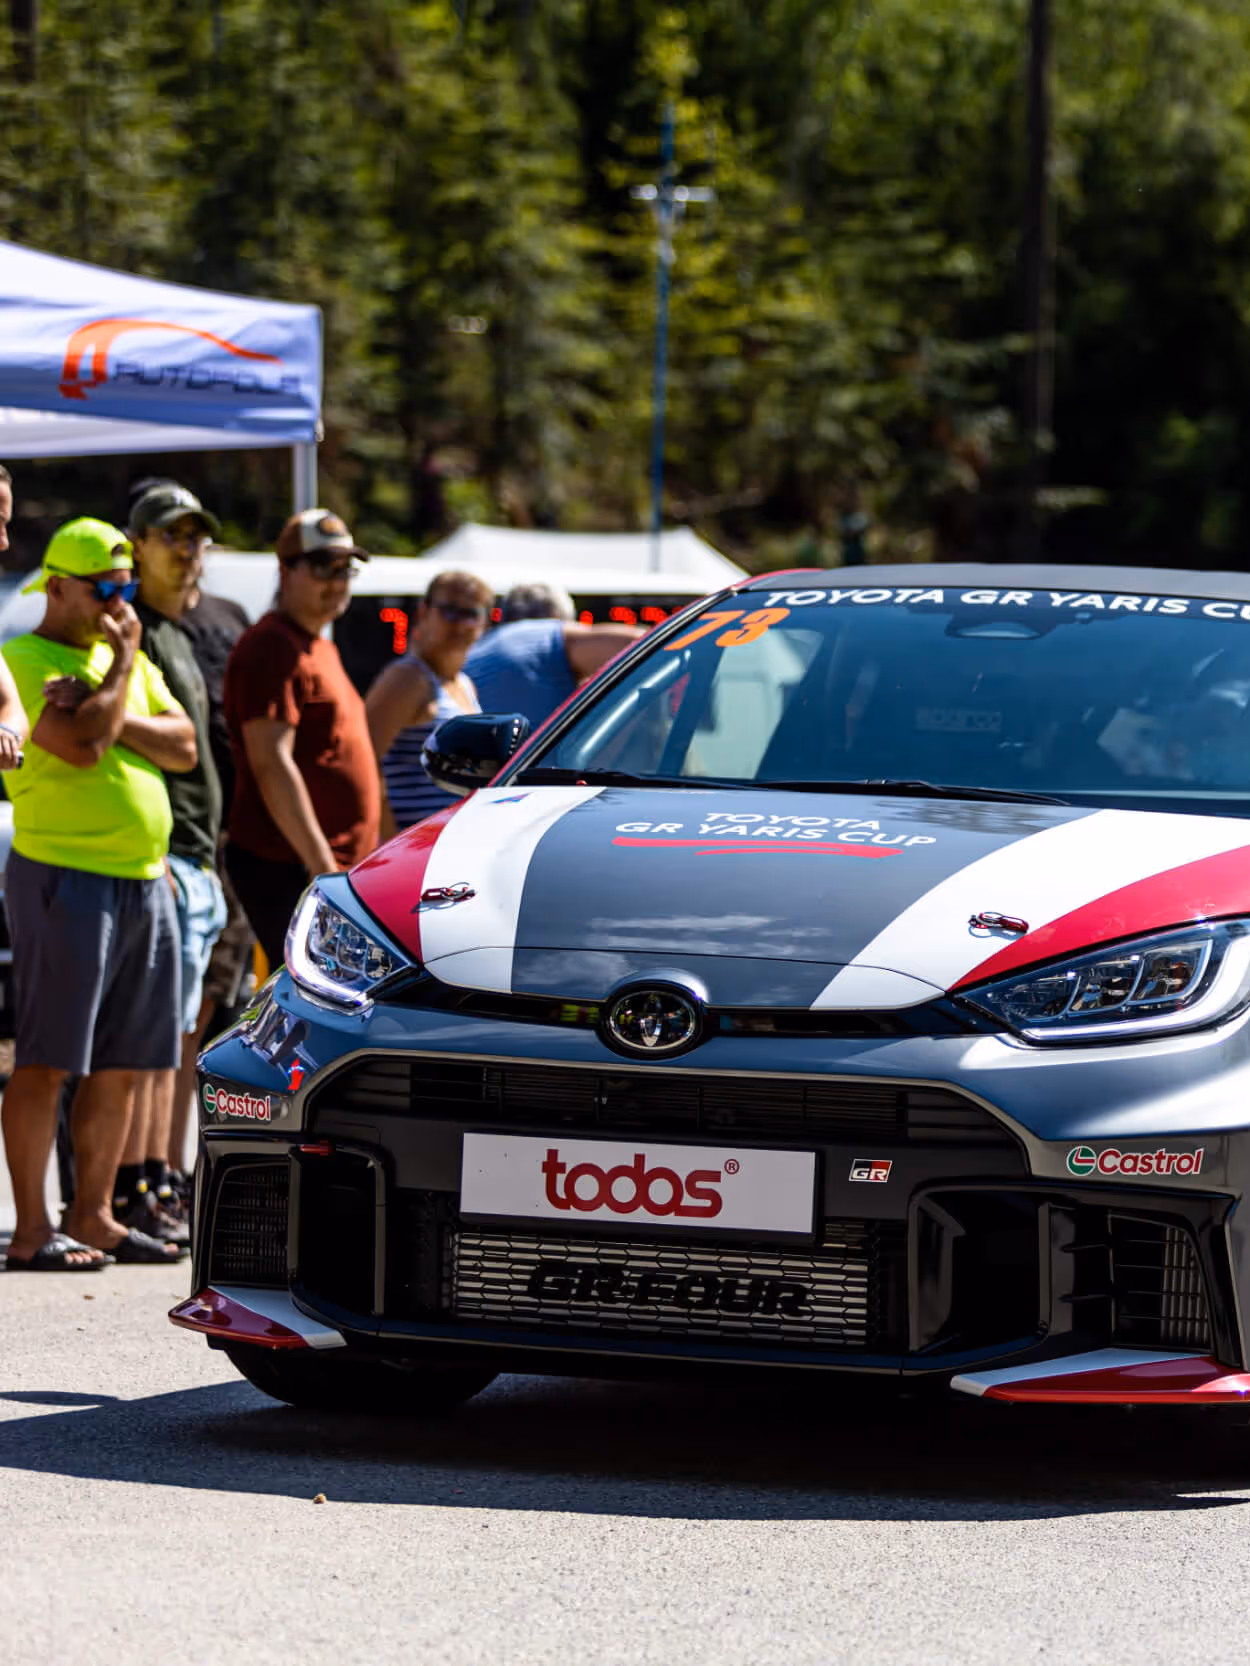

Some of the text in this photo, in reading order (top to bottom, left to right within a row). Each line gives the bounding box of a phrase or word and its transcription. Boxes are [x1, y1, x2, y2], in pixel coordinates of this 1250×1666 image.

[764, 589, 944, 607] TOYOTA
[960, 590, 1034, 606] GR
[1049, 592, 1190, 614] YARIS
[663, 607, 791, 651] 73
[704, 812, 880, 830] TOYOTA
[615, 822, 937, 847] GR YARIS CUP
[216, 1088, 272, 1121] Castrol
[1097, 1146, 1204, 1175] Castrol
[851, 1167, 888, 1181] GR
